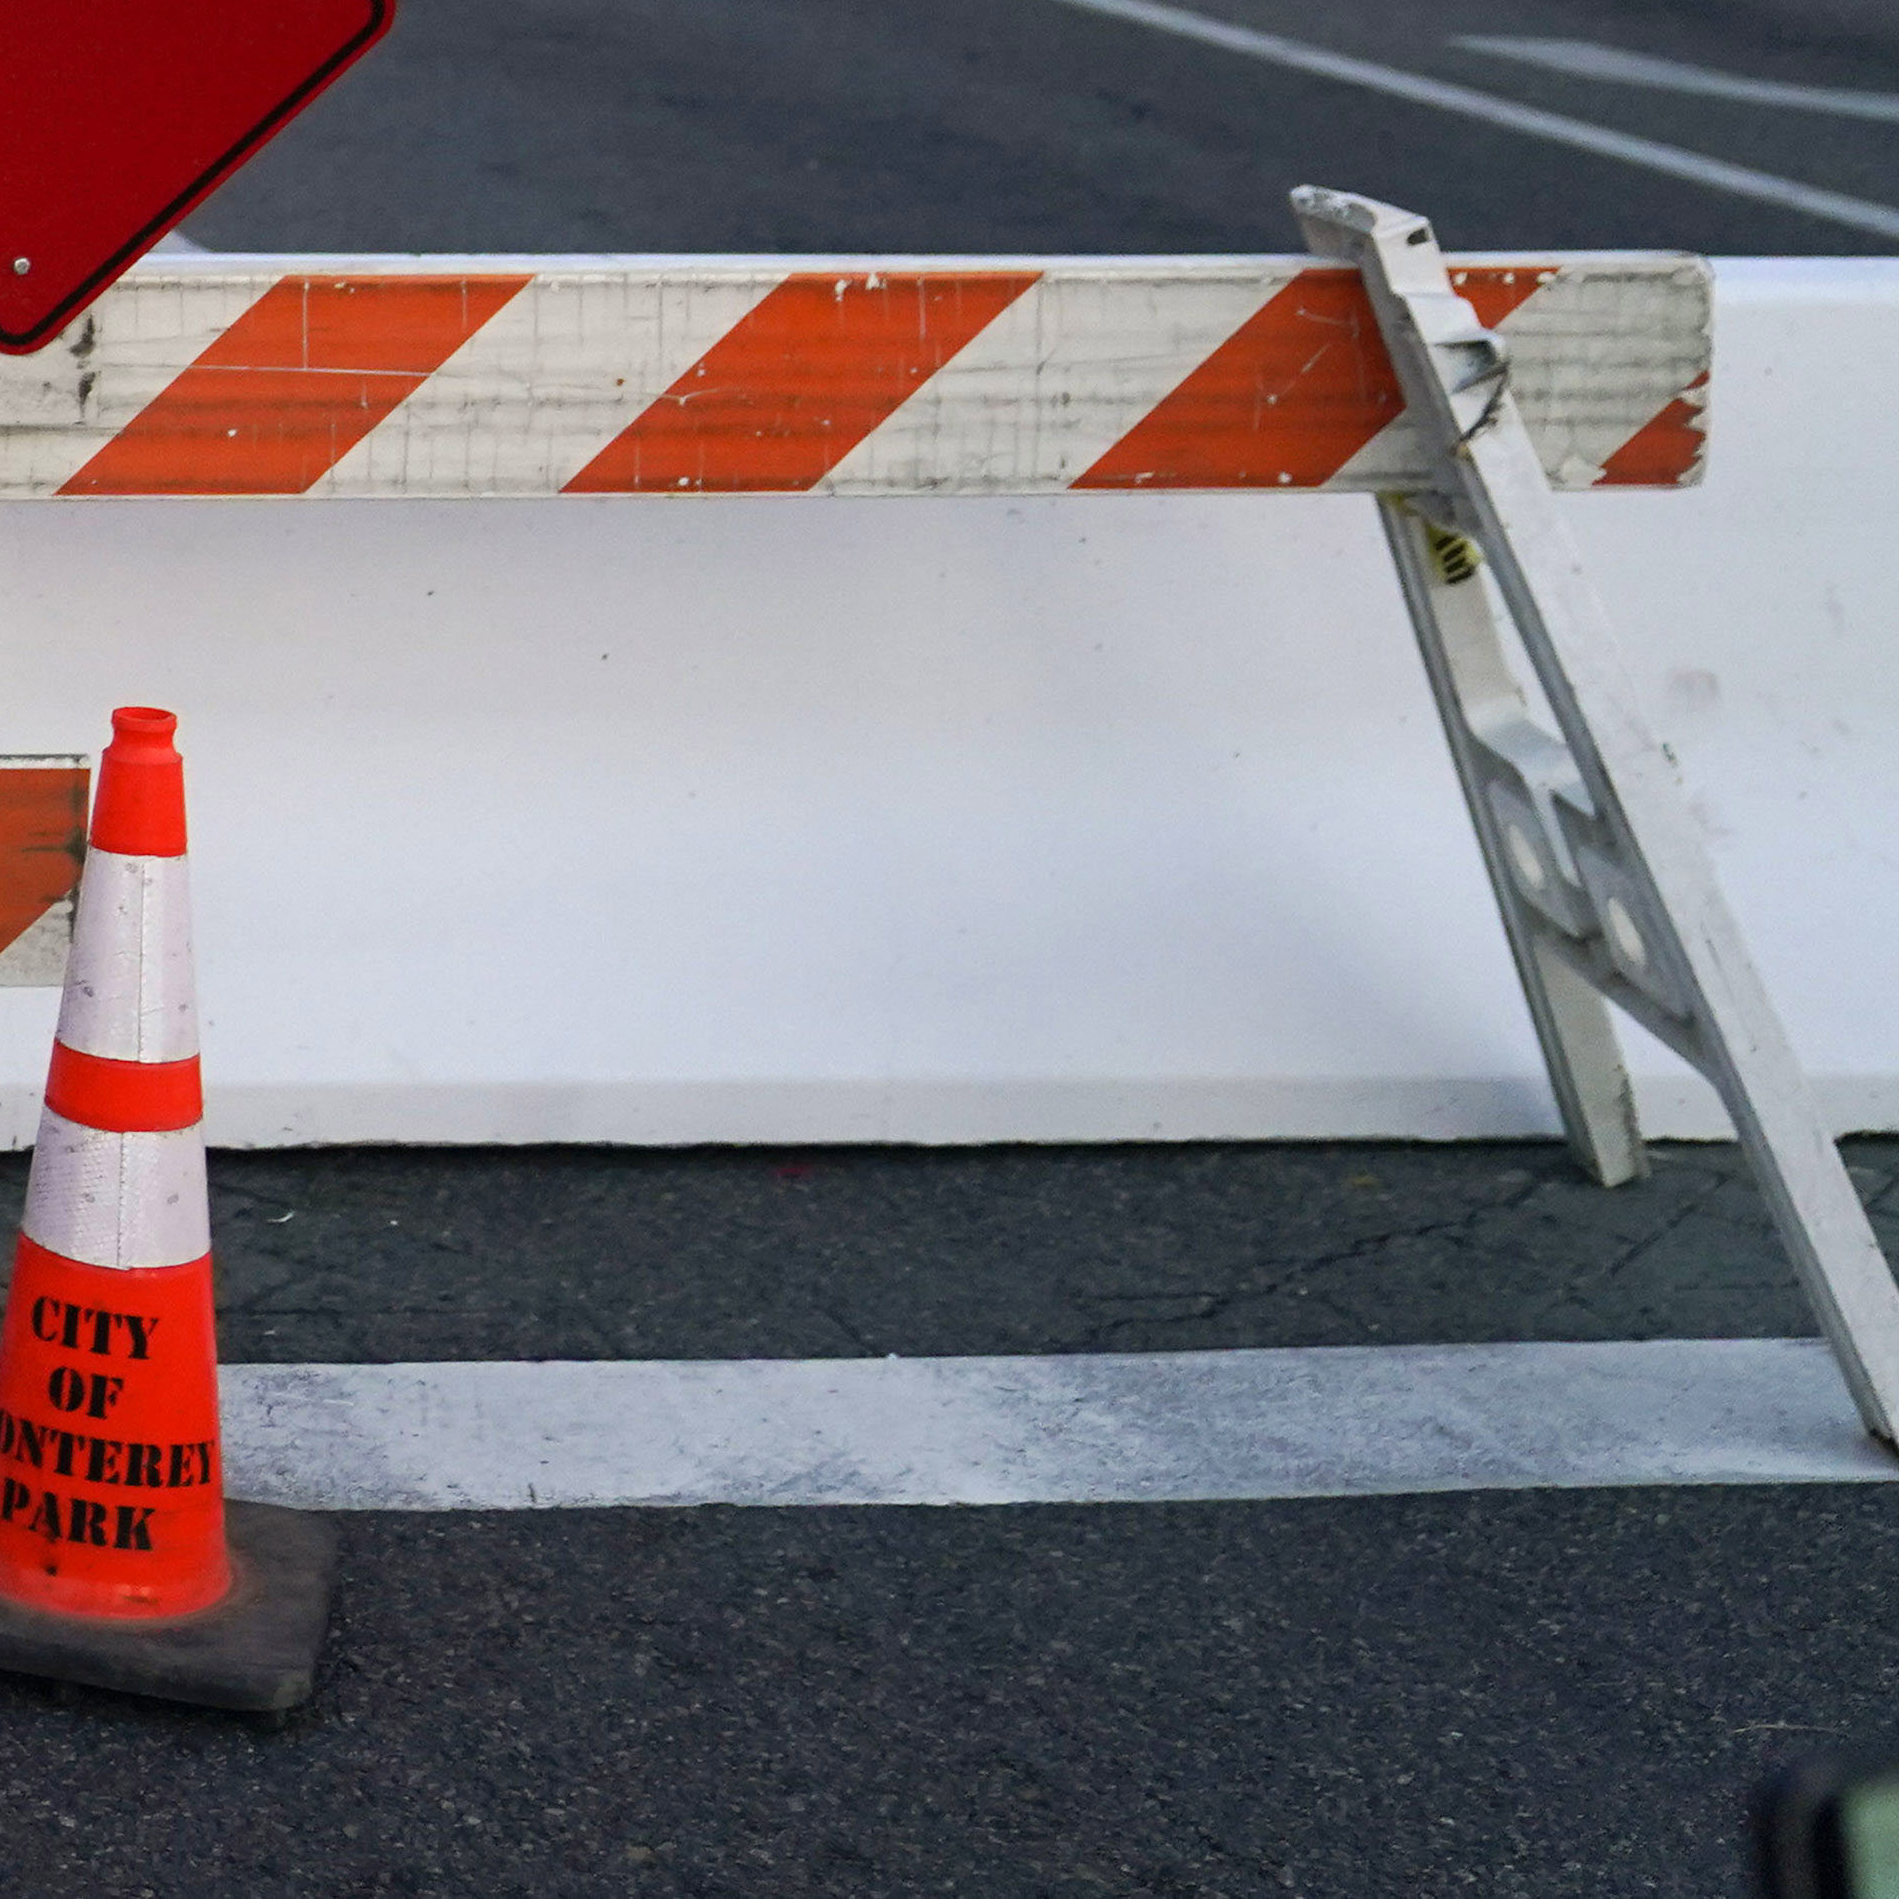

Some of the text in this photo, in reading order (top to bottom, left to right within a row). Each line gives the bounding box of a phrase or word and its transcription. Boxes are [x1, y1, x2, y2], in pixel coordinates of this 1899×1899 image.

[31, 1295, 158, 1360] CITY
[48, 1365, 124, 1420] OF
[0, 1476, 157, 1551] PARK
